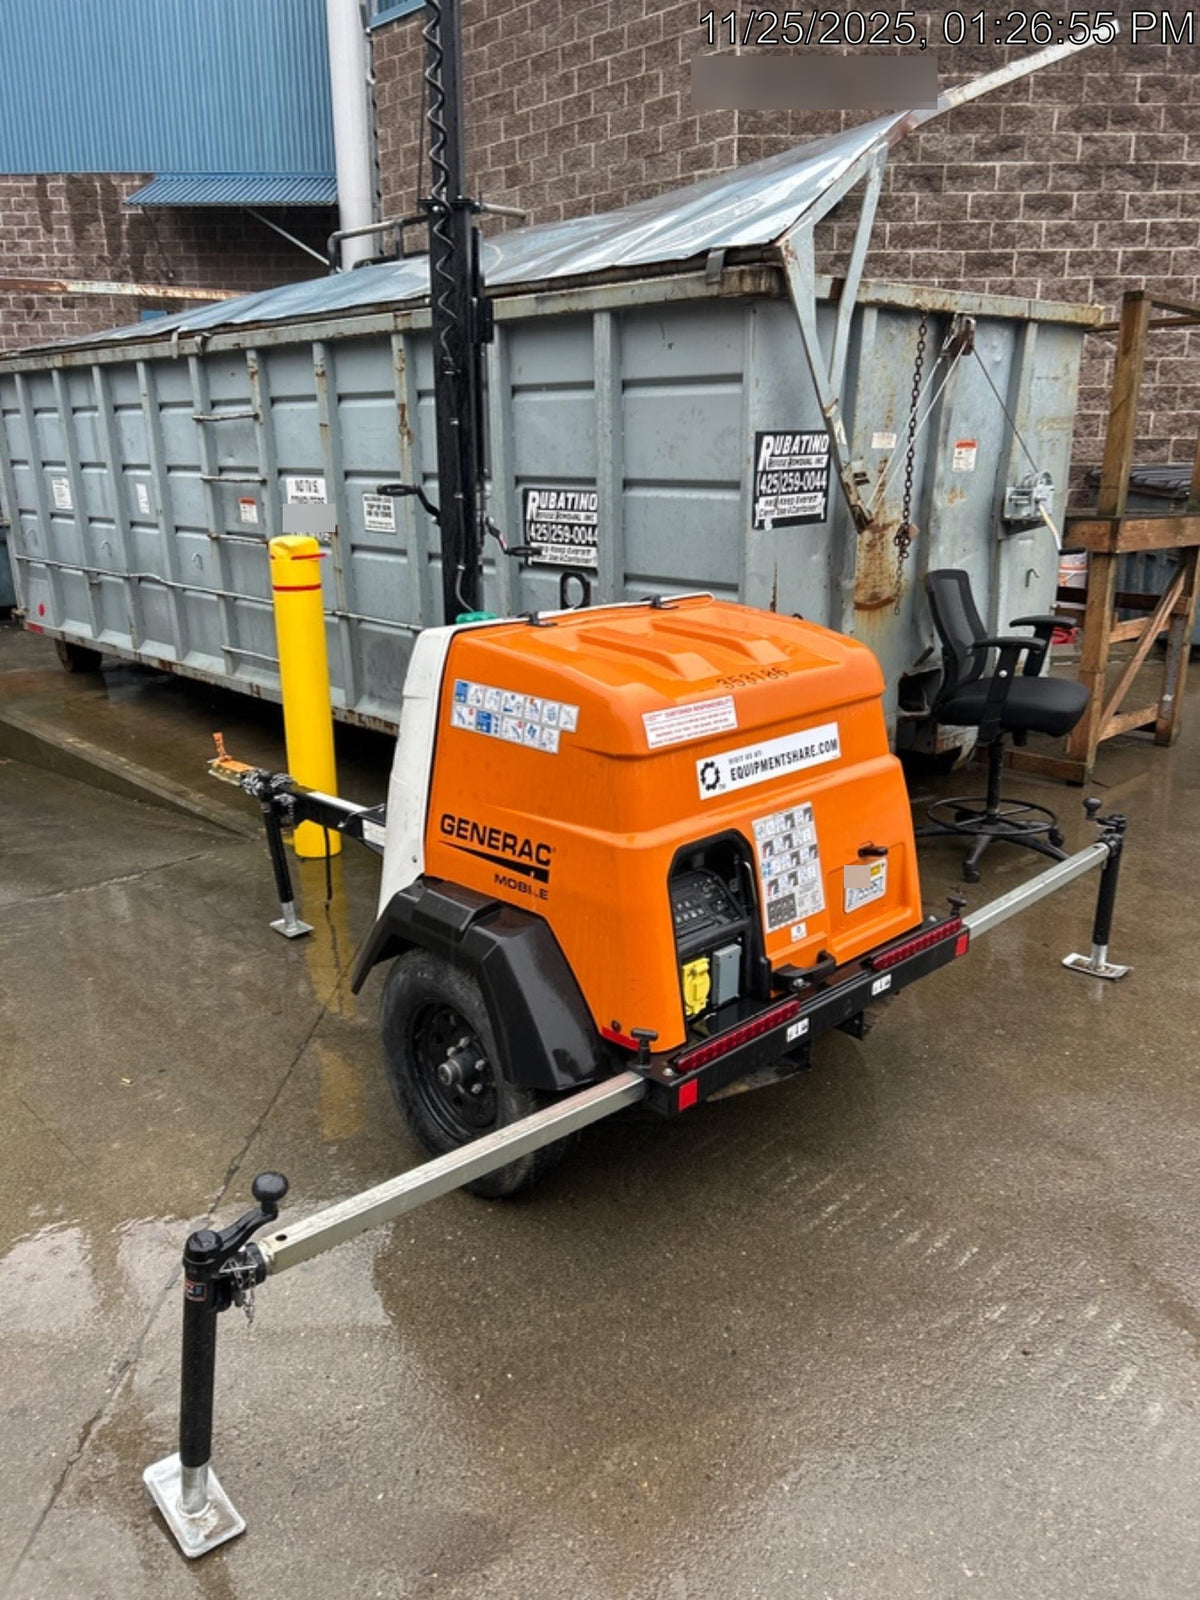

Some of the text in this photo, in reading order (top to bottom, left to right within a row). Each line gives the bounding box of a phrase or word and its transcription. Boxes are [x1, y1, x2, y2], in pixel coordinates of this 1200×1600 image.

[758, 435, 829, 471] RUBATINO
[526, 491, 598, 520] RUBATINO
[730, 738, 838, 781] EQUIPMENTSHARE.COM
[440, 813, 552, 867] GENERAC
